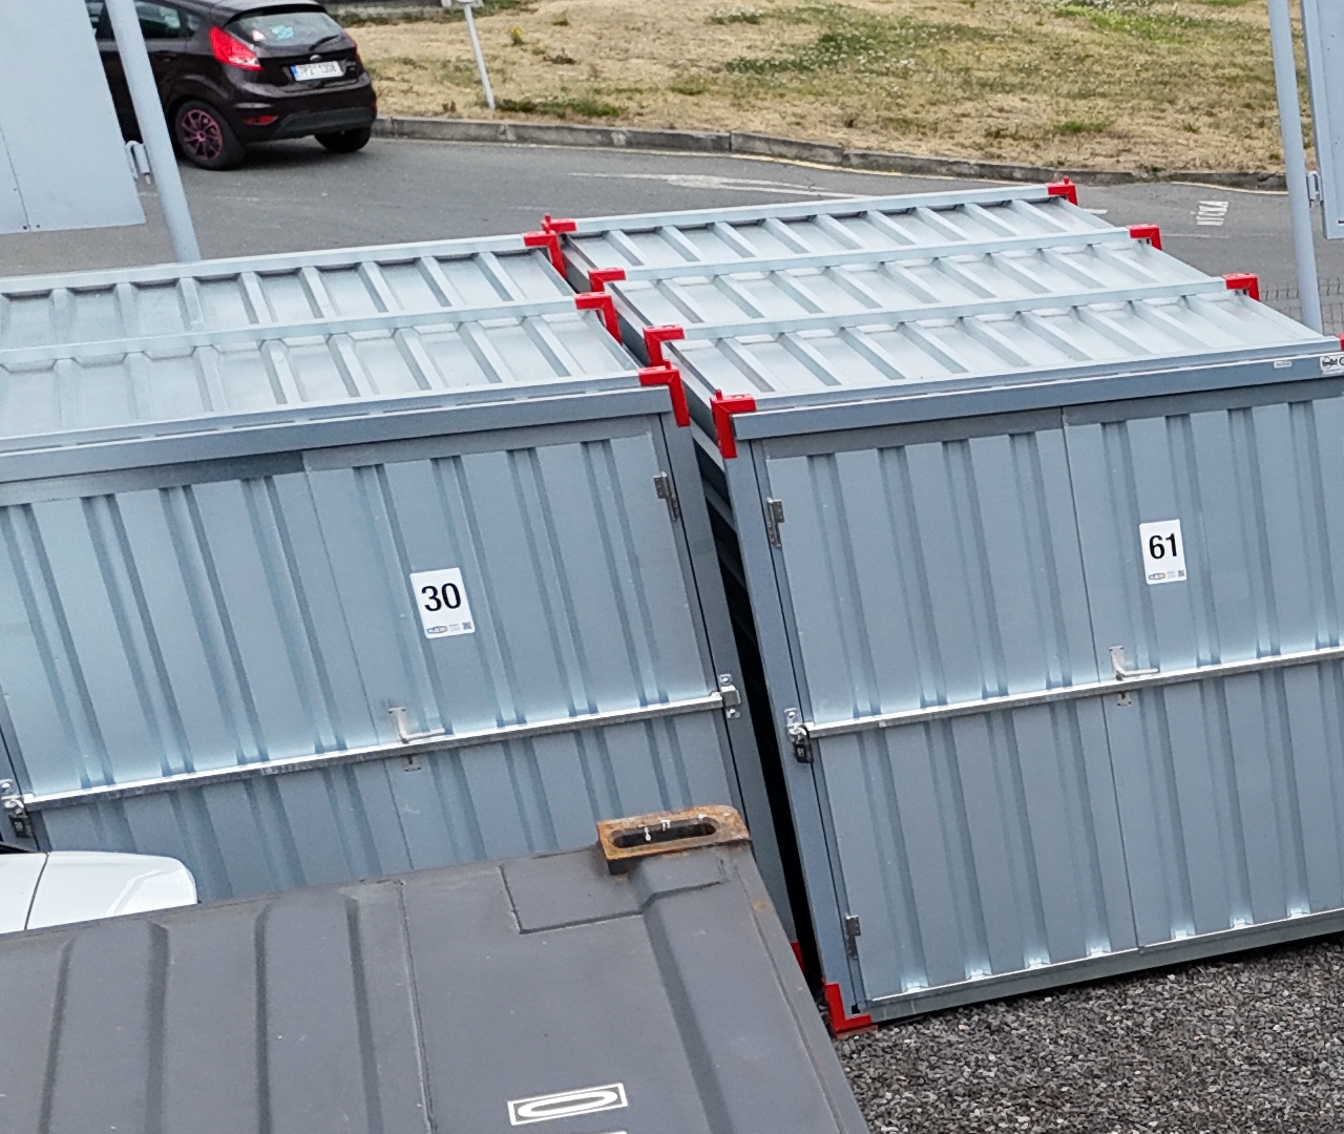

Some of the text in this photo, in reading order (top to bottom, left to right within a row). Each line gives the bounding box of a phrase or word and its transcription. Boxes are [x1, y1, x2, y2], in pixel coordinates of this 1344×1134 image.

[1149, 532, 1178, 560] 61
[421, 582, 462, 612] 30
[515, 1088, 620, 1120] 0
